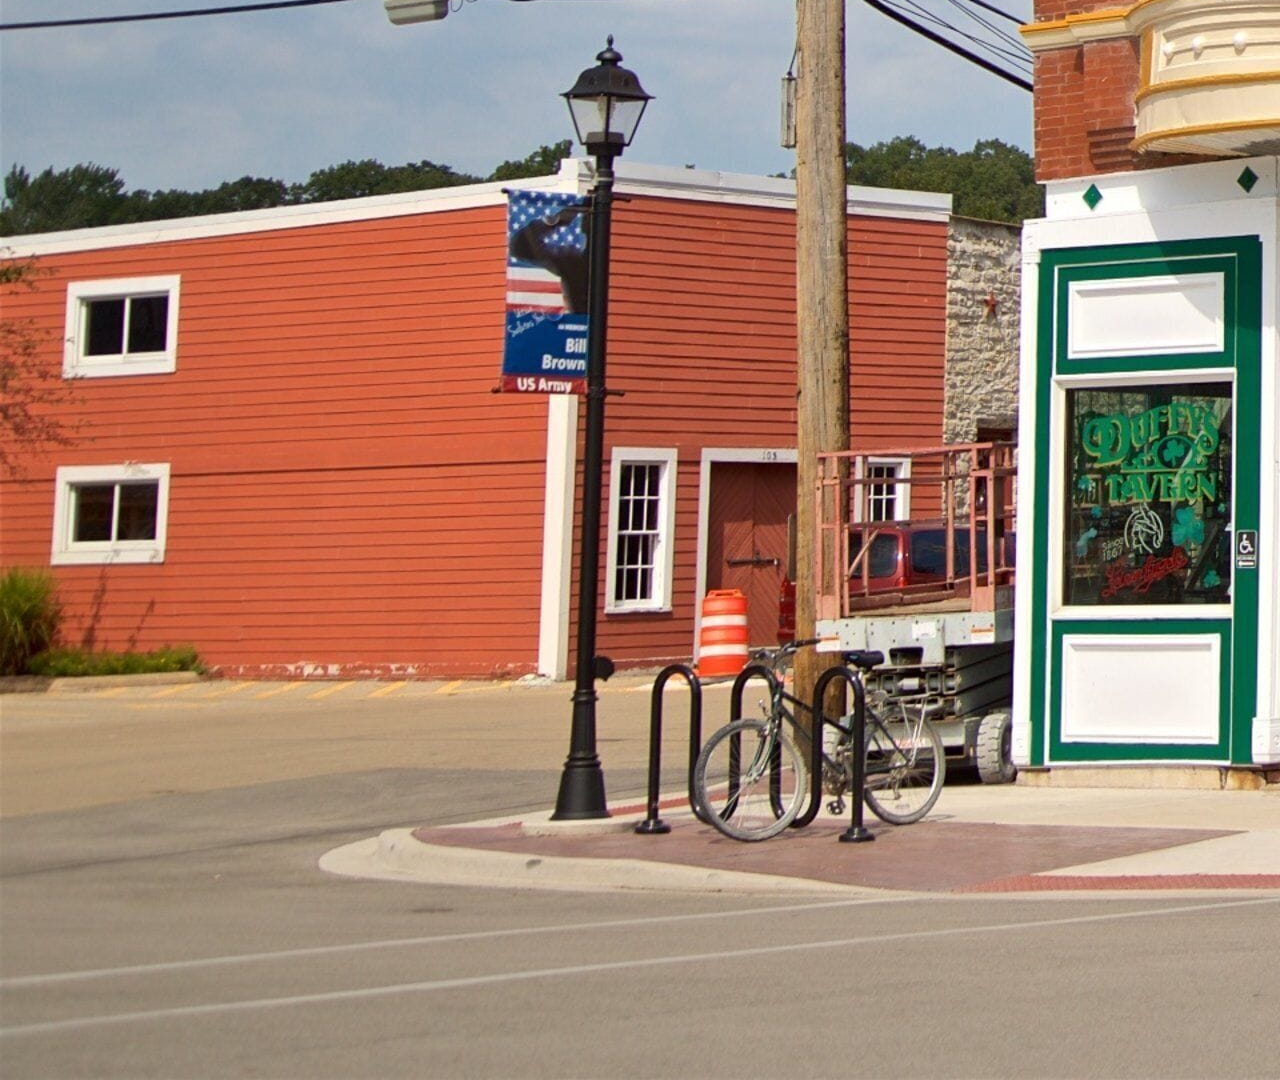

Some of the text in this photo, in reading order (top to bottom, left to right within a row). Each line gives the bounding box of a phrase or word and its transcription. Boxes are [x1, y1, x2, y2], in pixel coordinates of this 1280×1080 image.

[565, 338, 587, 353] Bill
[542, 354, 586, 370] Brown
[517, 377, 572, 393] US Army
[1104, 473, 1217, 503] TAVERN
